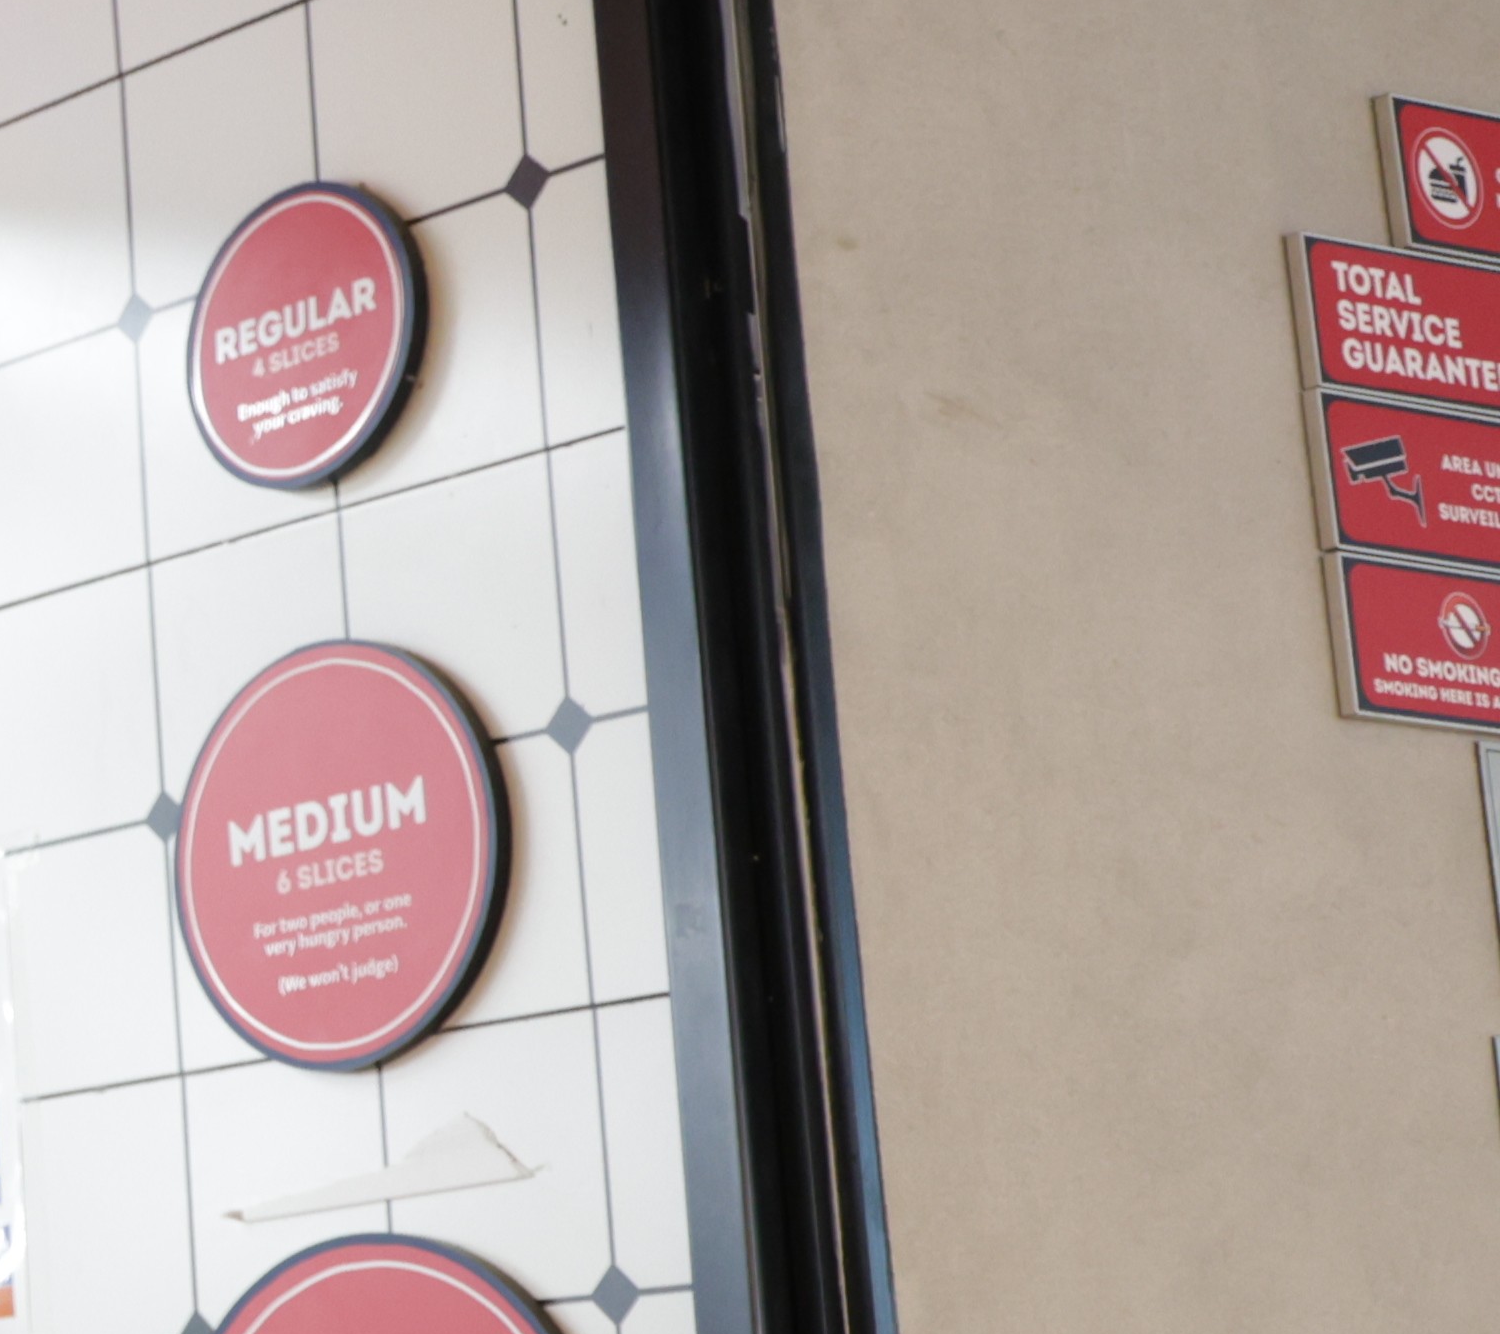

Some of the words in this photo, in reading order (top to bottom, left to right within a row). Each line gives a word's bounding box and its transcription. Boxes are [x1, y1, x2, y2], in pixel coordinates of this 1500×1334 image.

[1330, 260, 1422, 305] TOTAL
[214, 277, 377, 365] REGULAR
[1337, 299, 1462, 349] SERVICE
[253, 357, 265, 377] 4
[269, 331, 340, 374] SLICES
[1440, 454, 1482, 477] AREA
[1384, 652, 1413, 675] NO
[1415, 656, 1500, 687] SMOKING
[1374, 678, 1438, 701] SMOKING
[1440, 686, 1474, 707] HERE
[1475, 692, 1491, 709] IS
[227, 775, 427, 867] MEDIUM
[276, 869, 291, 895] 6
[296, 848, 385, 890] SLICES
[253, 922, 277, 940] For
[278, 916, 308, 934] two
[309, 901, 363, 932] people,
[364, 900, 382, 915] or
[383, 893, 412, 912] one
[264, 939, 297, 957] very
[297, 927, 351, 950] hungry
[352, 916, 408, 943] person.
[277, 974, 308, 997] (We
[308, 961, 350, 988] won't
[351, 954, 399, 985] judge)
